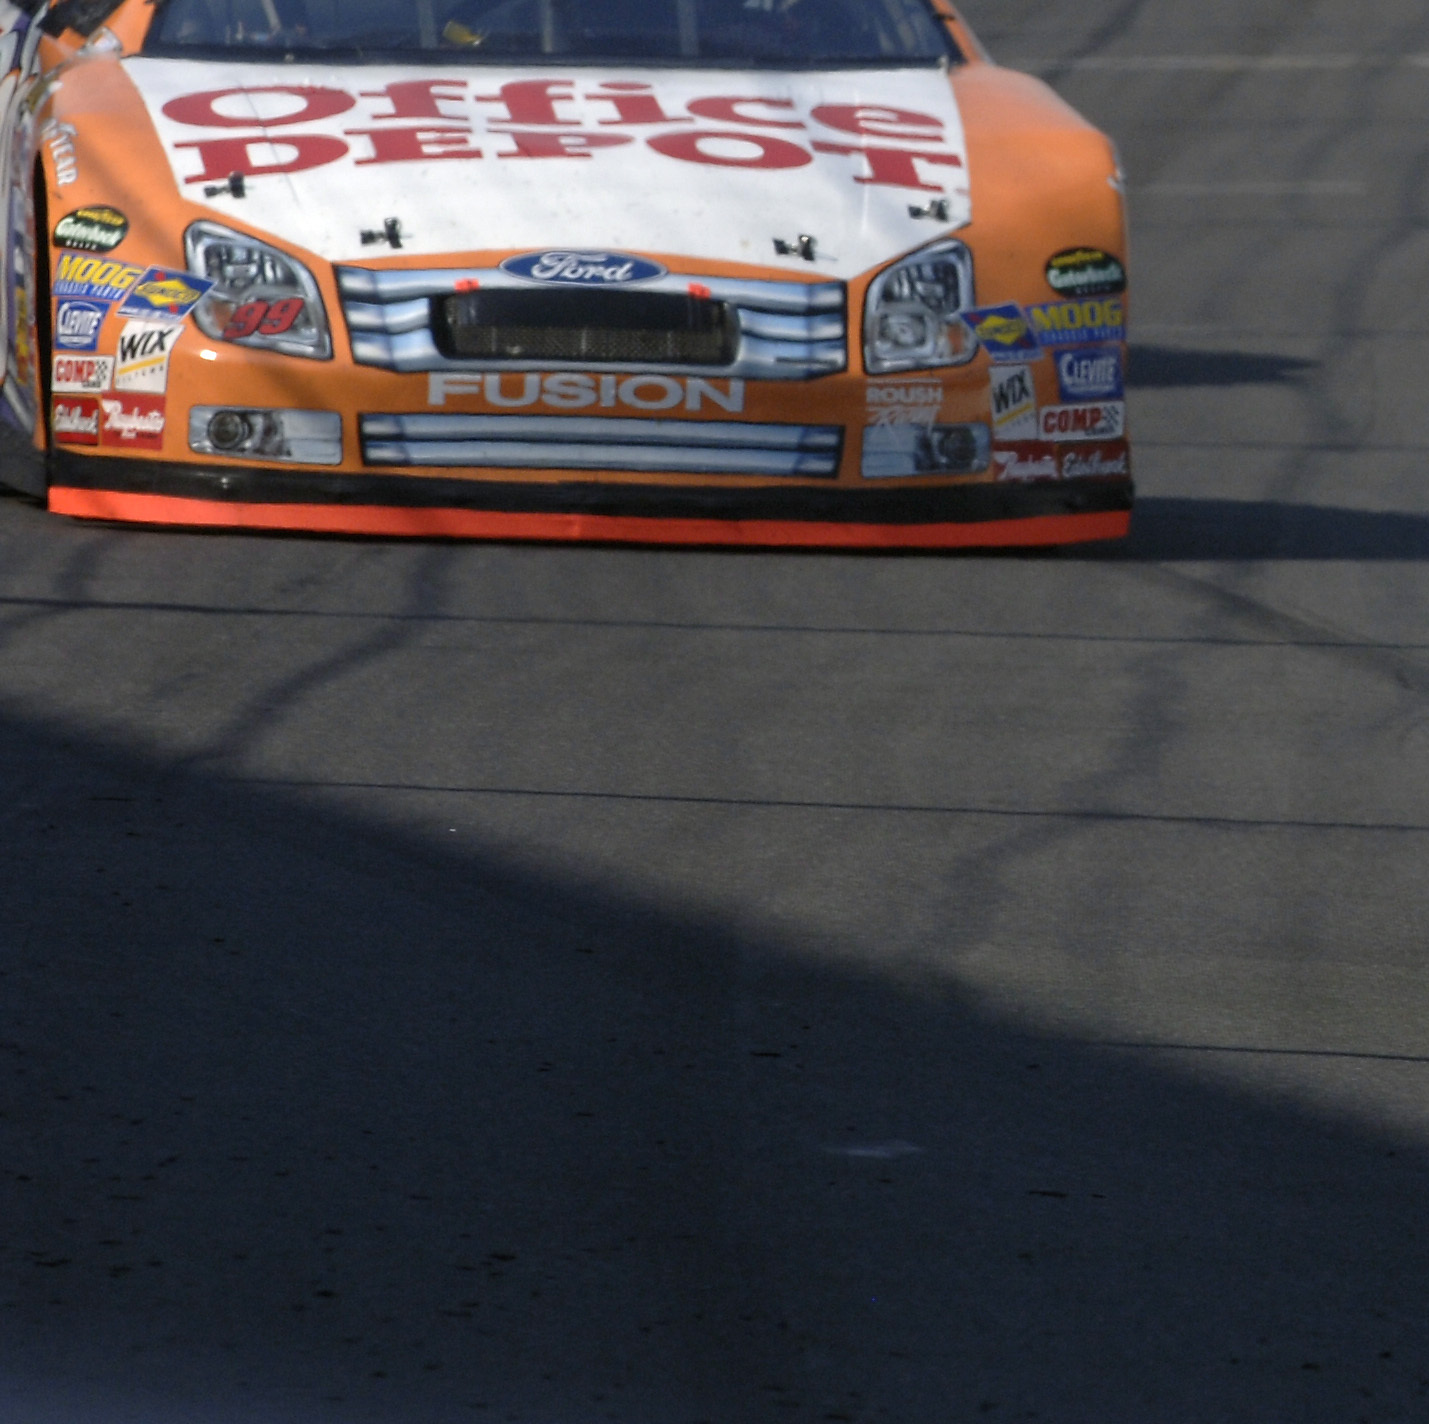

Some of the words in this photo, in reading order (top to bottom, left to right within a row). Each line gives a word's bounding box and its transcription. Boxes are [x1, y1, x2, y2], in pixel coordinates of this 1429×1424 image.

[161, 78, 945, 143] Office
[173, 127, 962, 193] DEPOT
[60, 255, 143, 290] MOOG
[530, 252, 634, 283] Ford
[221, 297, 305, 339] 99
[1030, 299, 1123, 330] MOOG
[120, 328, 174, 362] WIX
[55, 358, 97, 382] COMP
[426, 374, 746, 413] FUSION
[866, 386, 944, 404] ROUSH
[993, 373, 1031, 414] WIX
[1043, 407, 1102, 434] COMP
